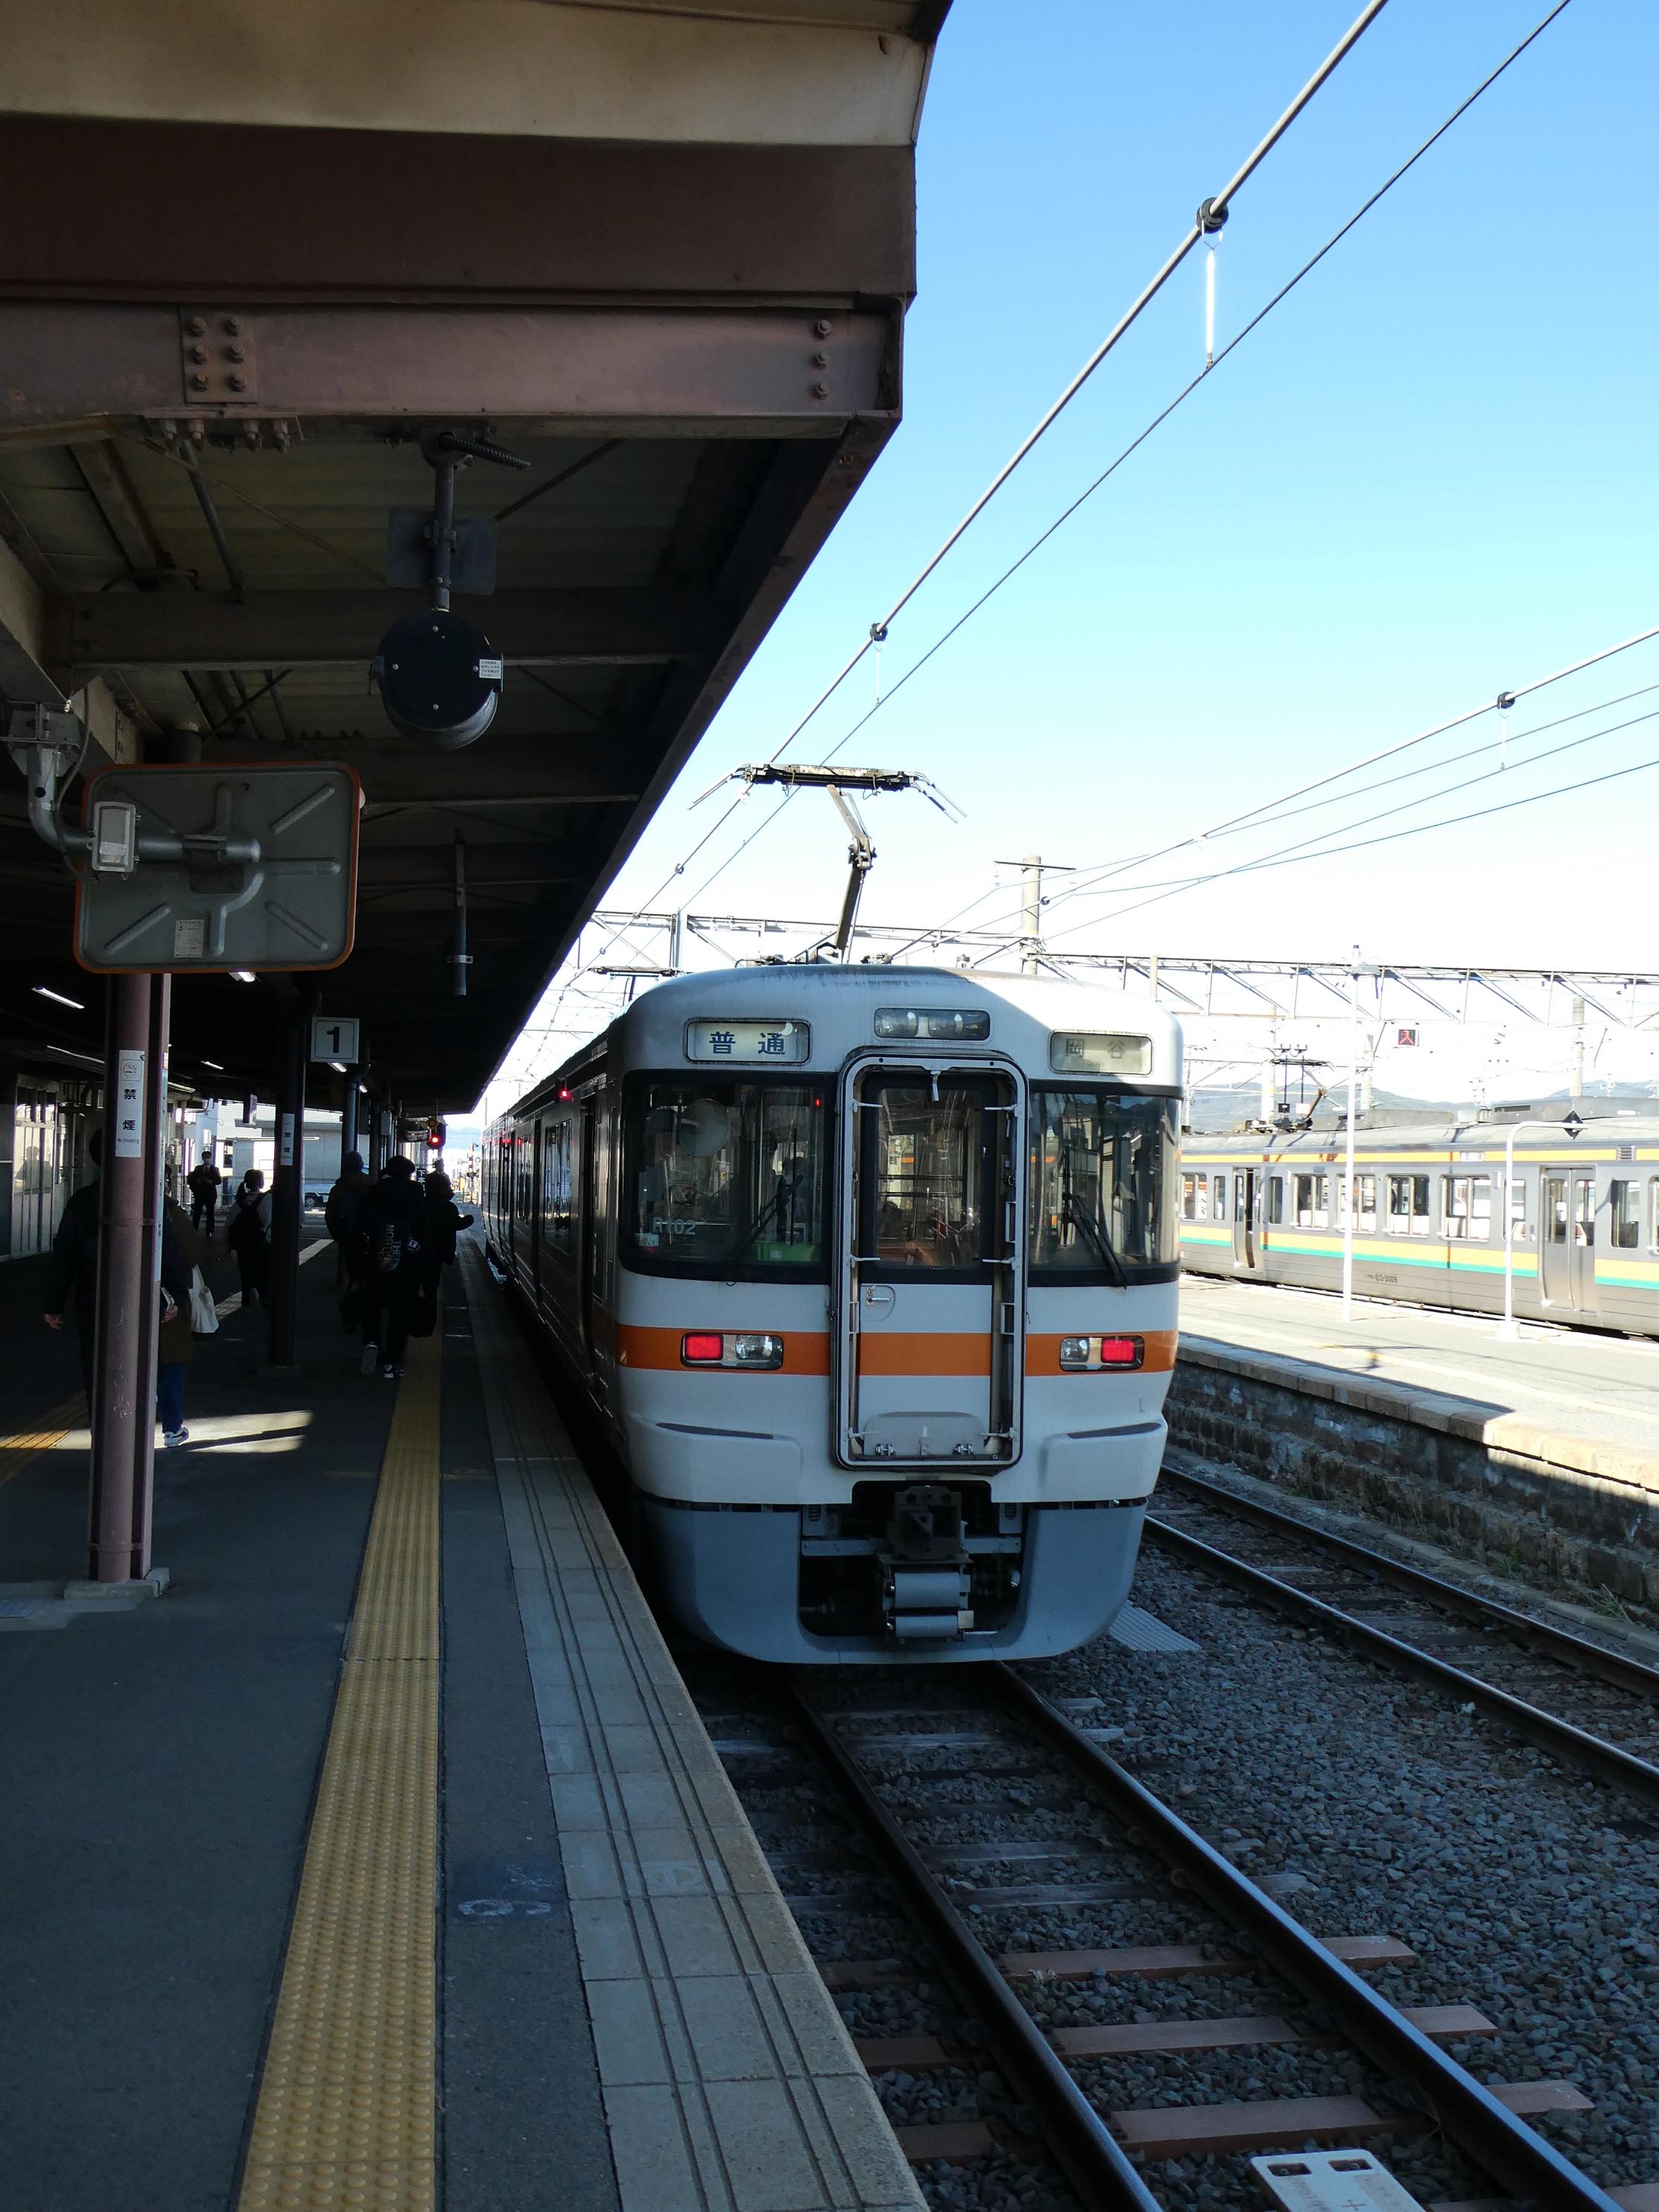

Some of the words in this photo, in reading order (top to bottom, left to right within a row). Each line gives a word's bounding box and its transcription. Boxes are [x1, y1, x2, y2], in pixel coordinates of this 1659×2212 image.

[326, 1026, 340, 1053] 1
[709, 1031, 786, 1055] 普通
[1065, 1038, 1126, 1059] 岡谷
[122, 1088, 137, 1131] 禁煙
[393, 1239, 402, 1258] THE
